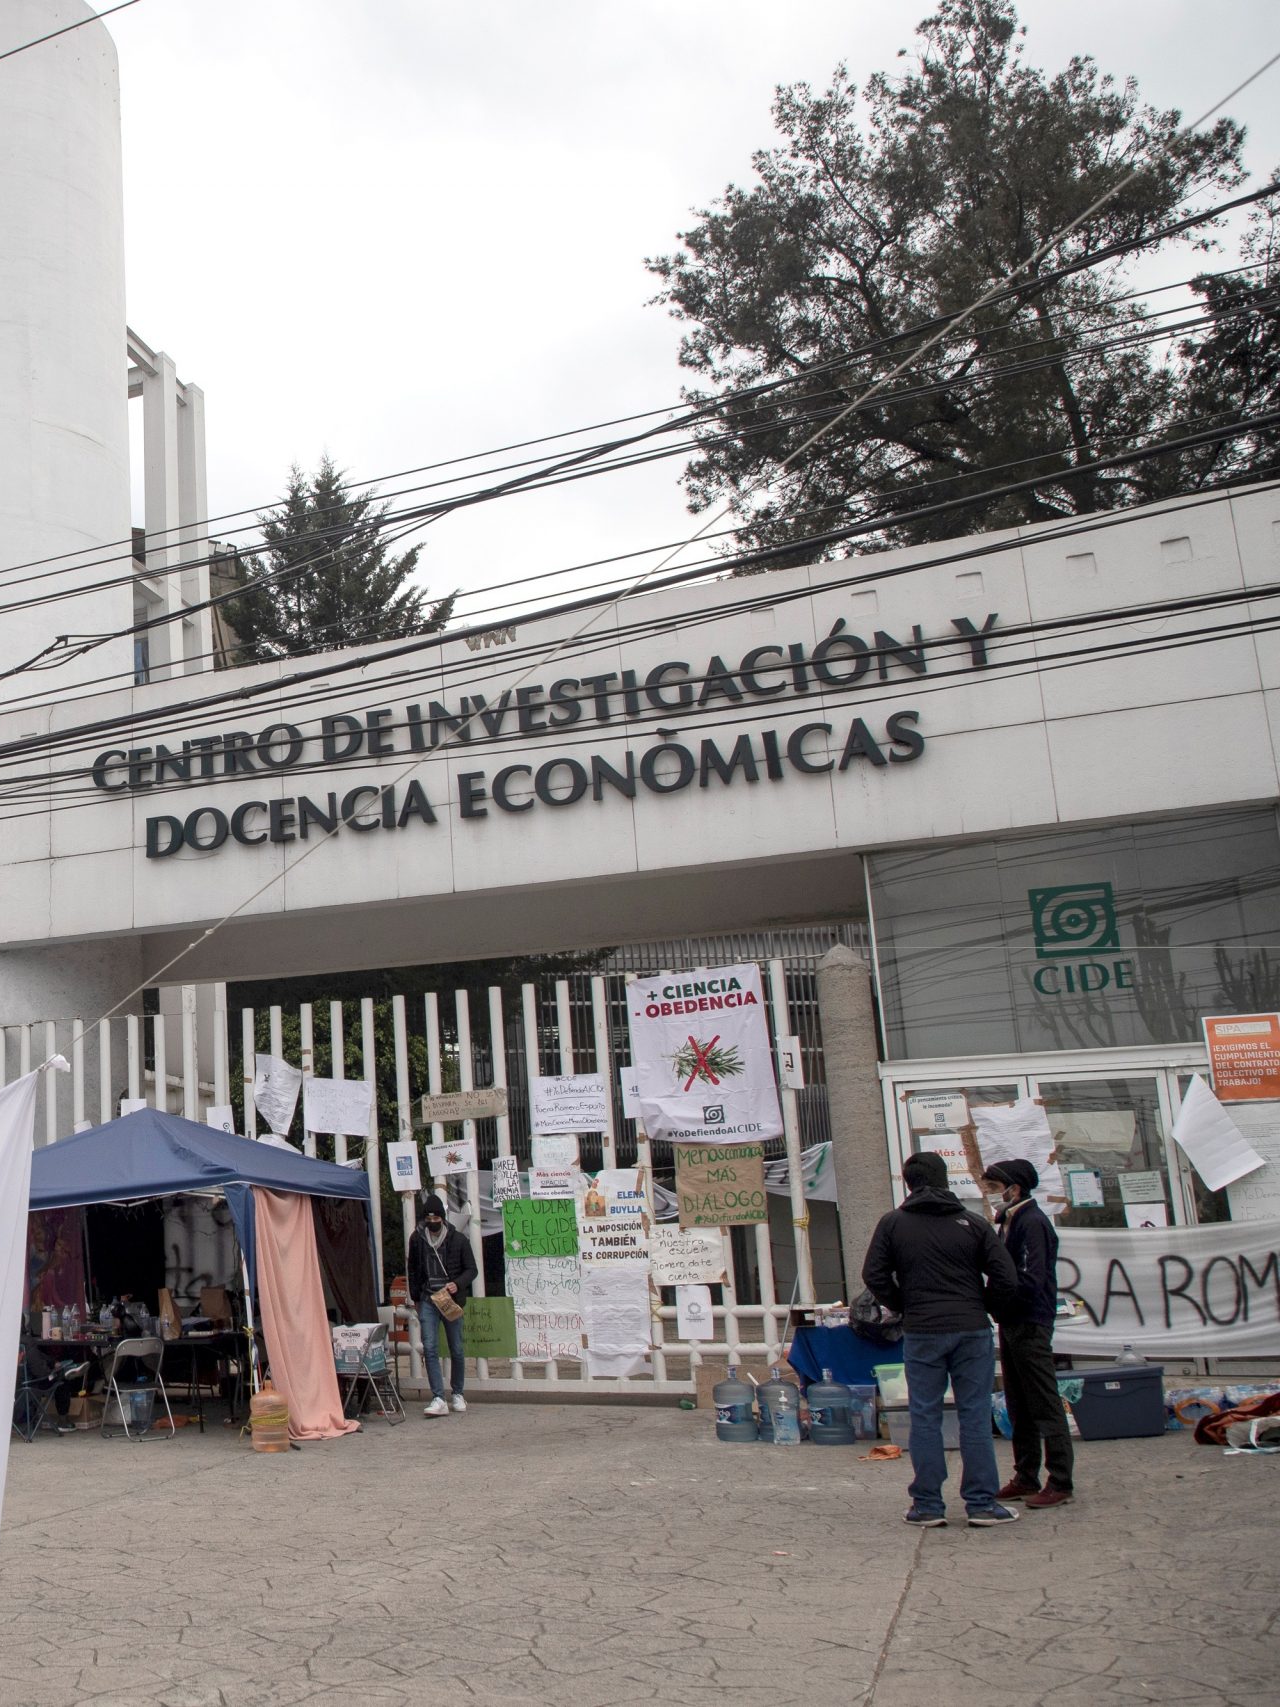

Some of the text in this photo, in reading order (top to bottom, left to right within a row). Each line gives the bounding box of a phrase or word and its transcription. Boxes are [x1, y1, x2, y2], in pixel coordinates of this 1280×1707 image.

[91, 613, 999, 794] CENTRO DE INVESTIGACIÓN Y
[146, 778, 438, 860] DOCENCIA
[1033, 958, 1135, 995] CIDE
[663, 977, 742, 1000] CIENCIA
[645, 991, 758, 1018] OBEDENCIA
[1215, 1050, 1280, 1060] CUMPLIMIENTO
[1234, 1060, 1280, 1068] CONTRATO
[1217, 1069, 1264, 1078] COLECTIVO
[617, 1190, 645, 1199] ELENA
[683, 1191, 764, 1213] DIÁLOGO
[610, 1205, 643, 1214] BUYLLA
[521, 1219, 539, 1236] EL
[597, 1221, 642, 1232] IMPOSICIÓN
[591, 1234, 636, 1246] TAMBIÉN
[582, 1248, 649, 1260] ES CORRUPCIÓN
